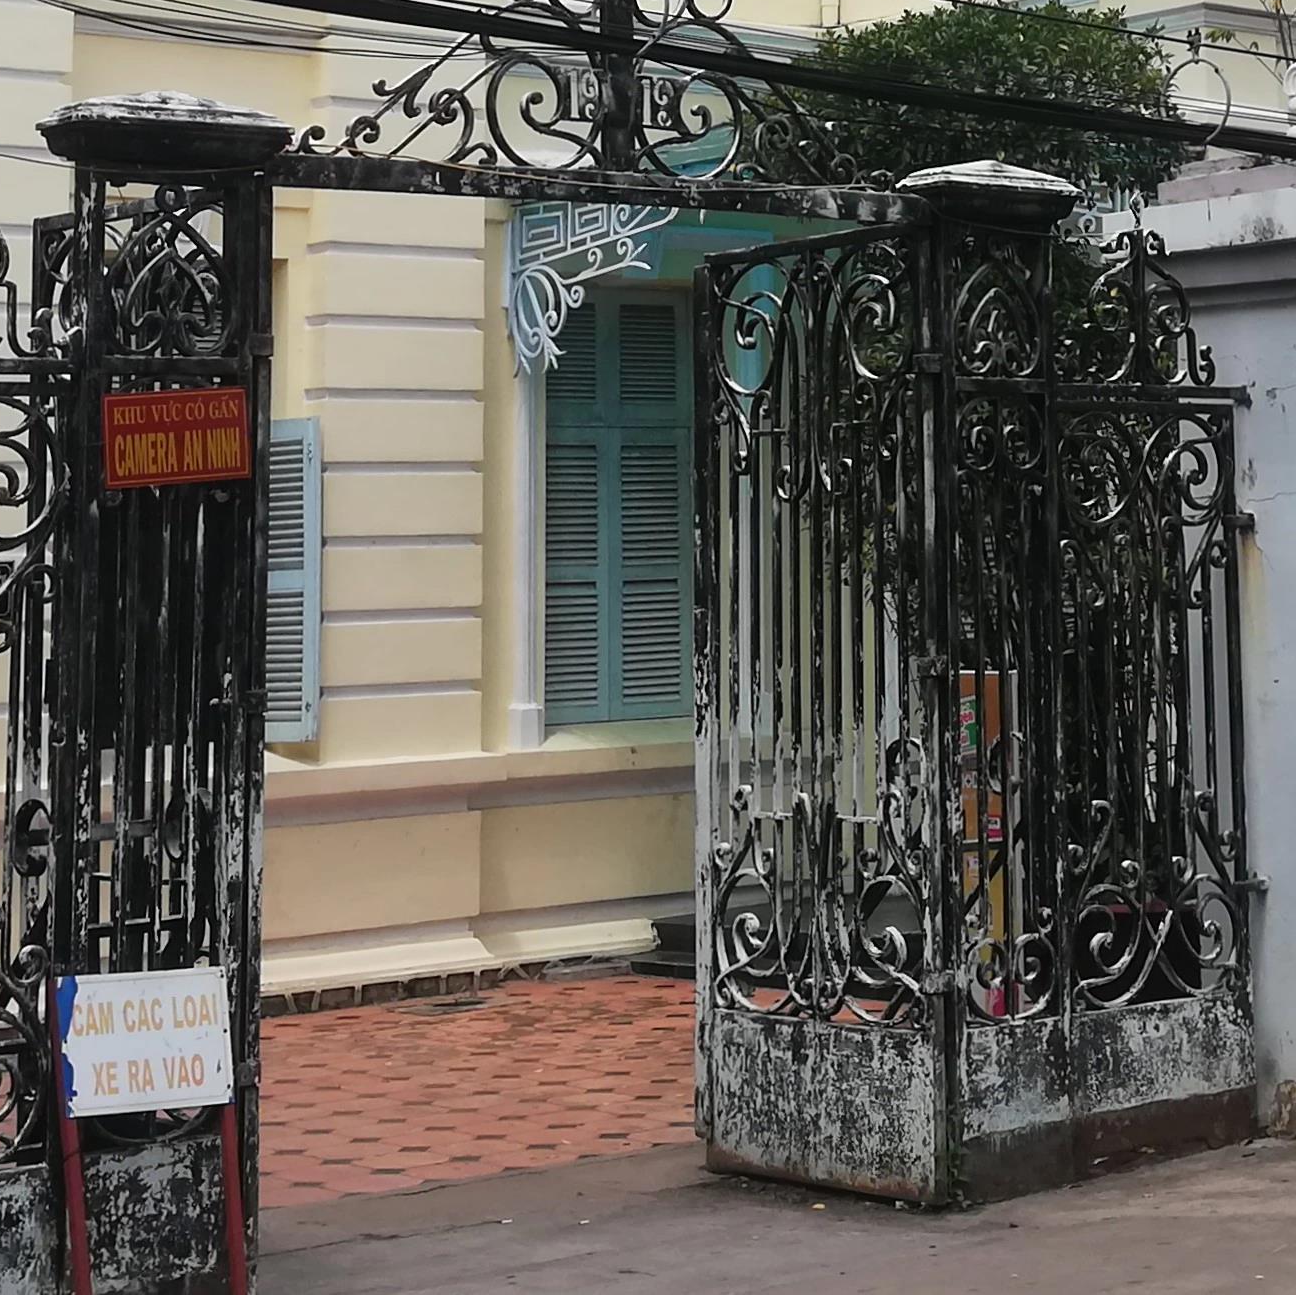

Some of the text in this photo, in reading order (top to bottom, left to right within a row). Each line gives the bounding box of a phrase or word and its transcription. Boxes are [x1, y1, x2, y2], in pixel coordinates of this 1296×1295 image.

[113, 405, 146, 425] KHU
[152, 400, 181, 425] VỰC
[185, 397, 205, 421] CÓ
[115, 427, 241, 477] CAMERA AN NINH
[92, 1061, 119, 1096] XE
[127, 1058, 154, 1093] RA
